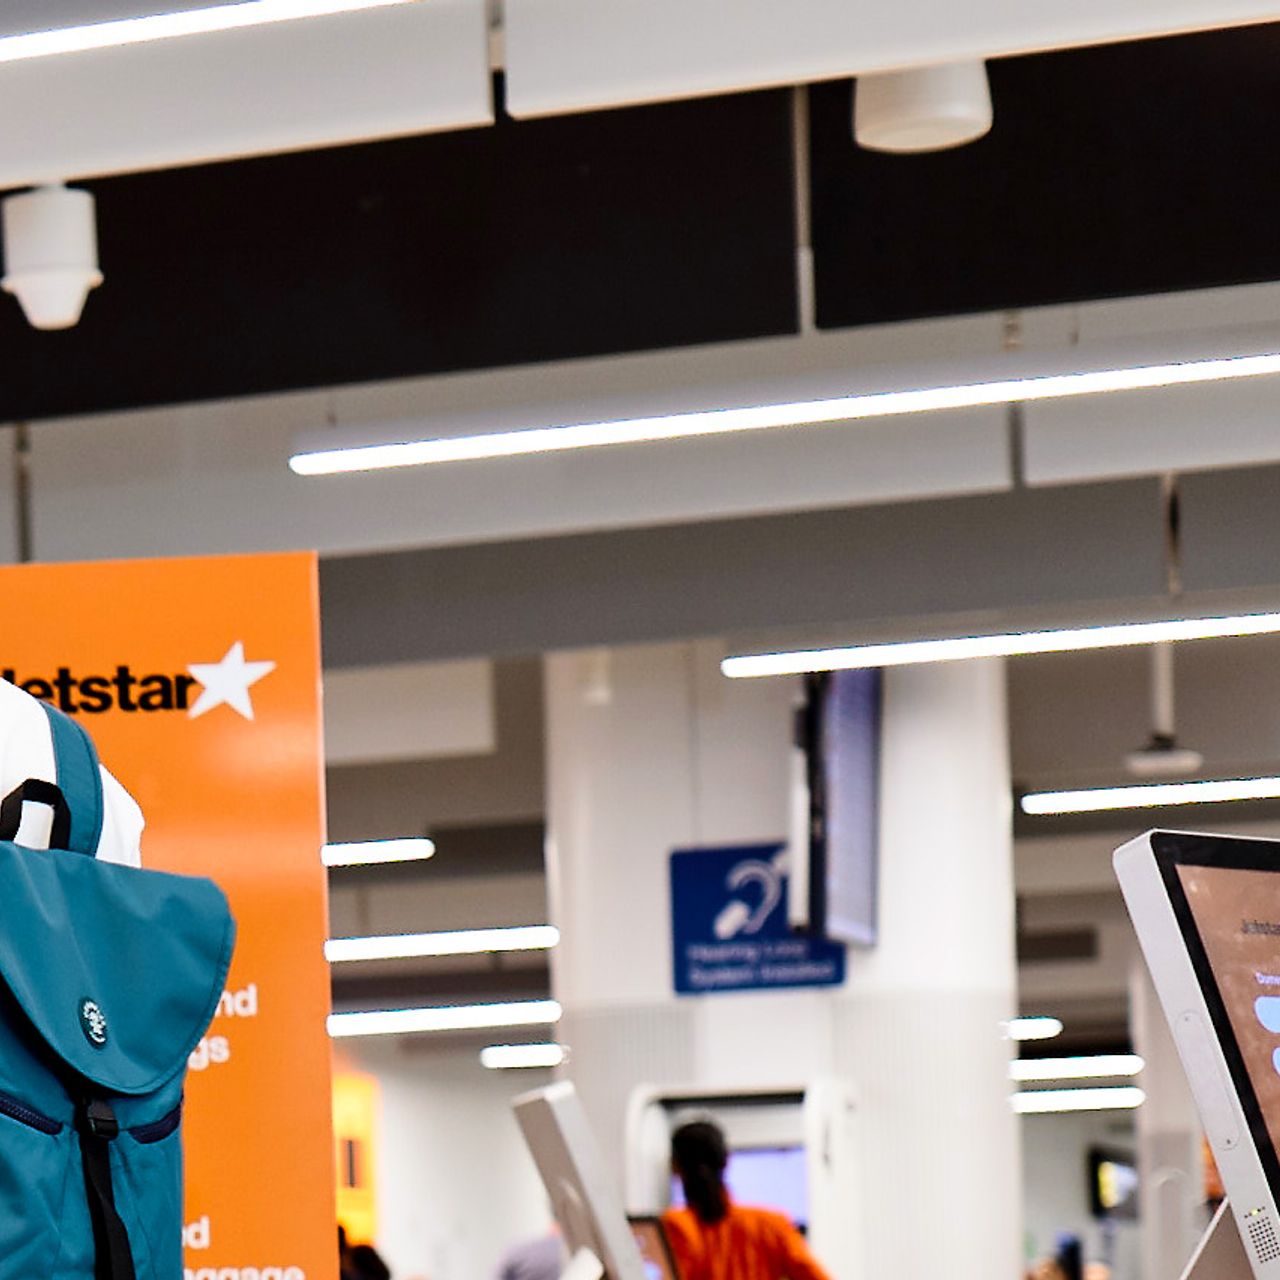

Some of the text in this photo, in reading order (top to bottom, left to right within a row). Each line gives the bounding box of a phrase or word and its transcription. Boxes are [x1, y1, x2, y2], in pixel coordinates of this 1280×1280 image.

[2, 667, 200, 715] etstar
[215, 984, 258, 1017] nd
[188, 1035, 231, 1070] gs
